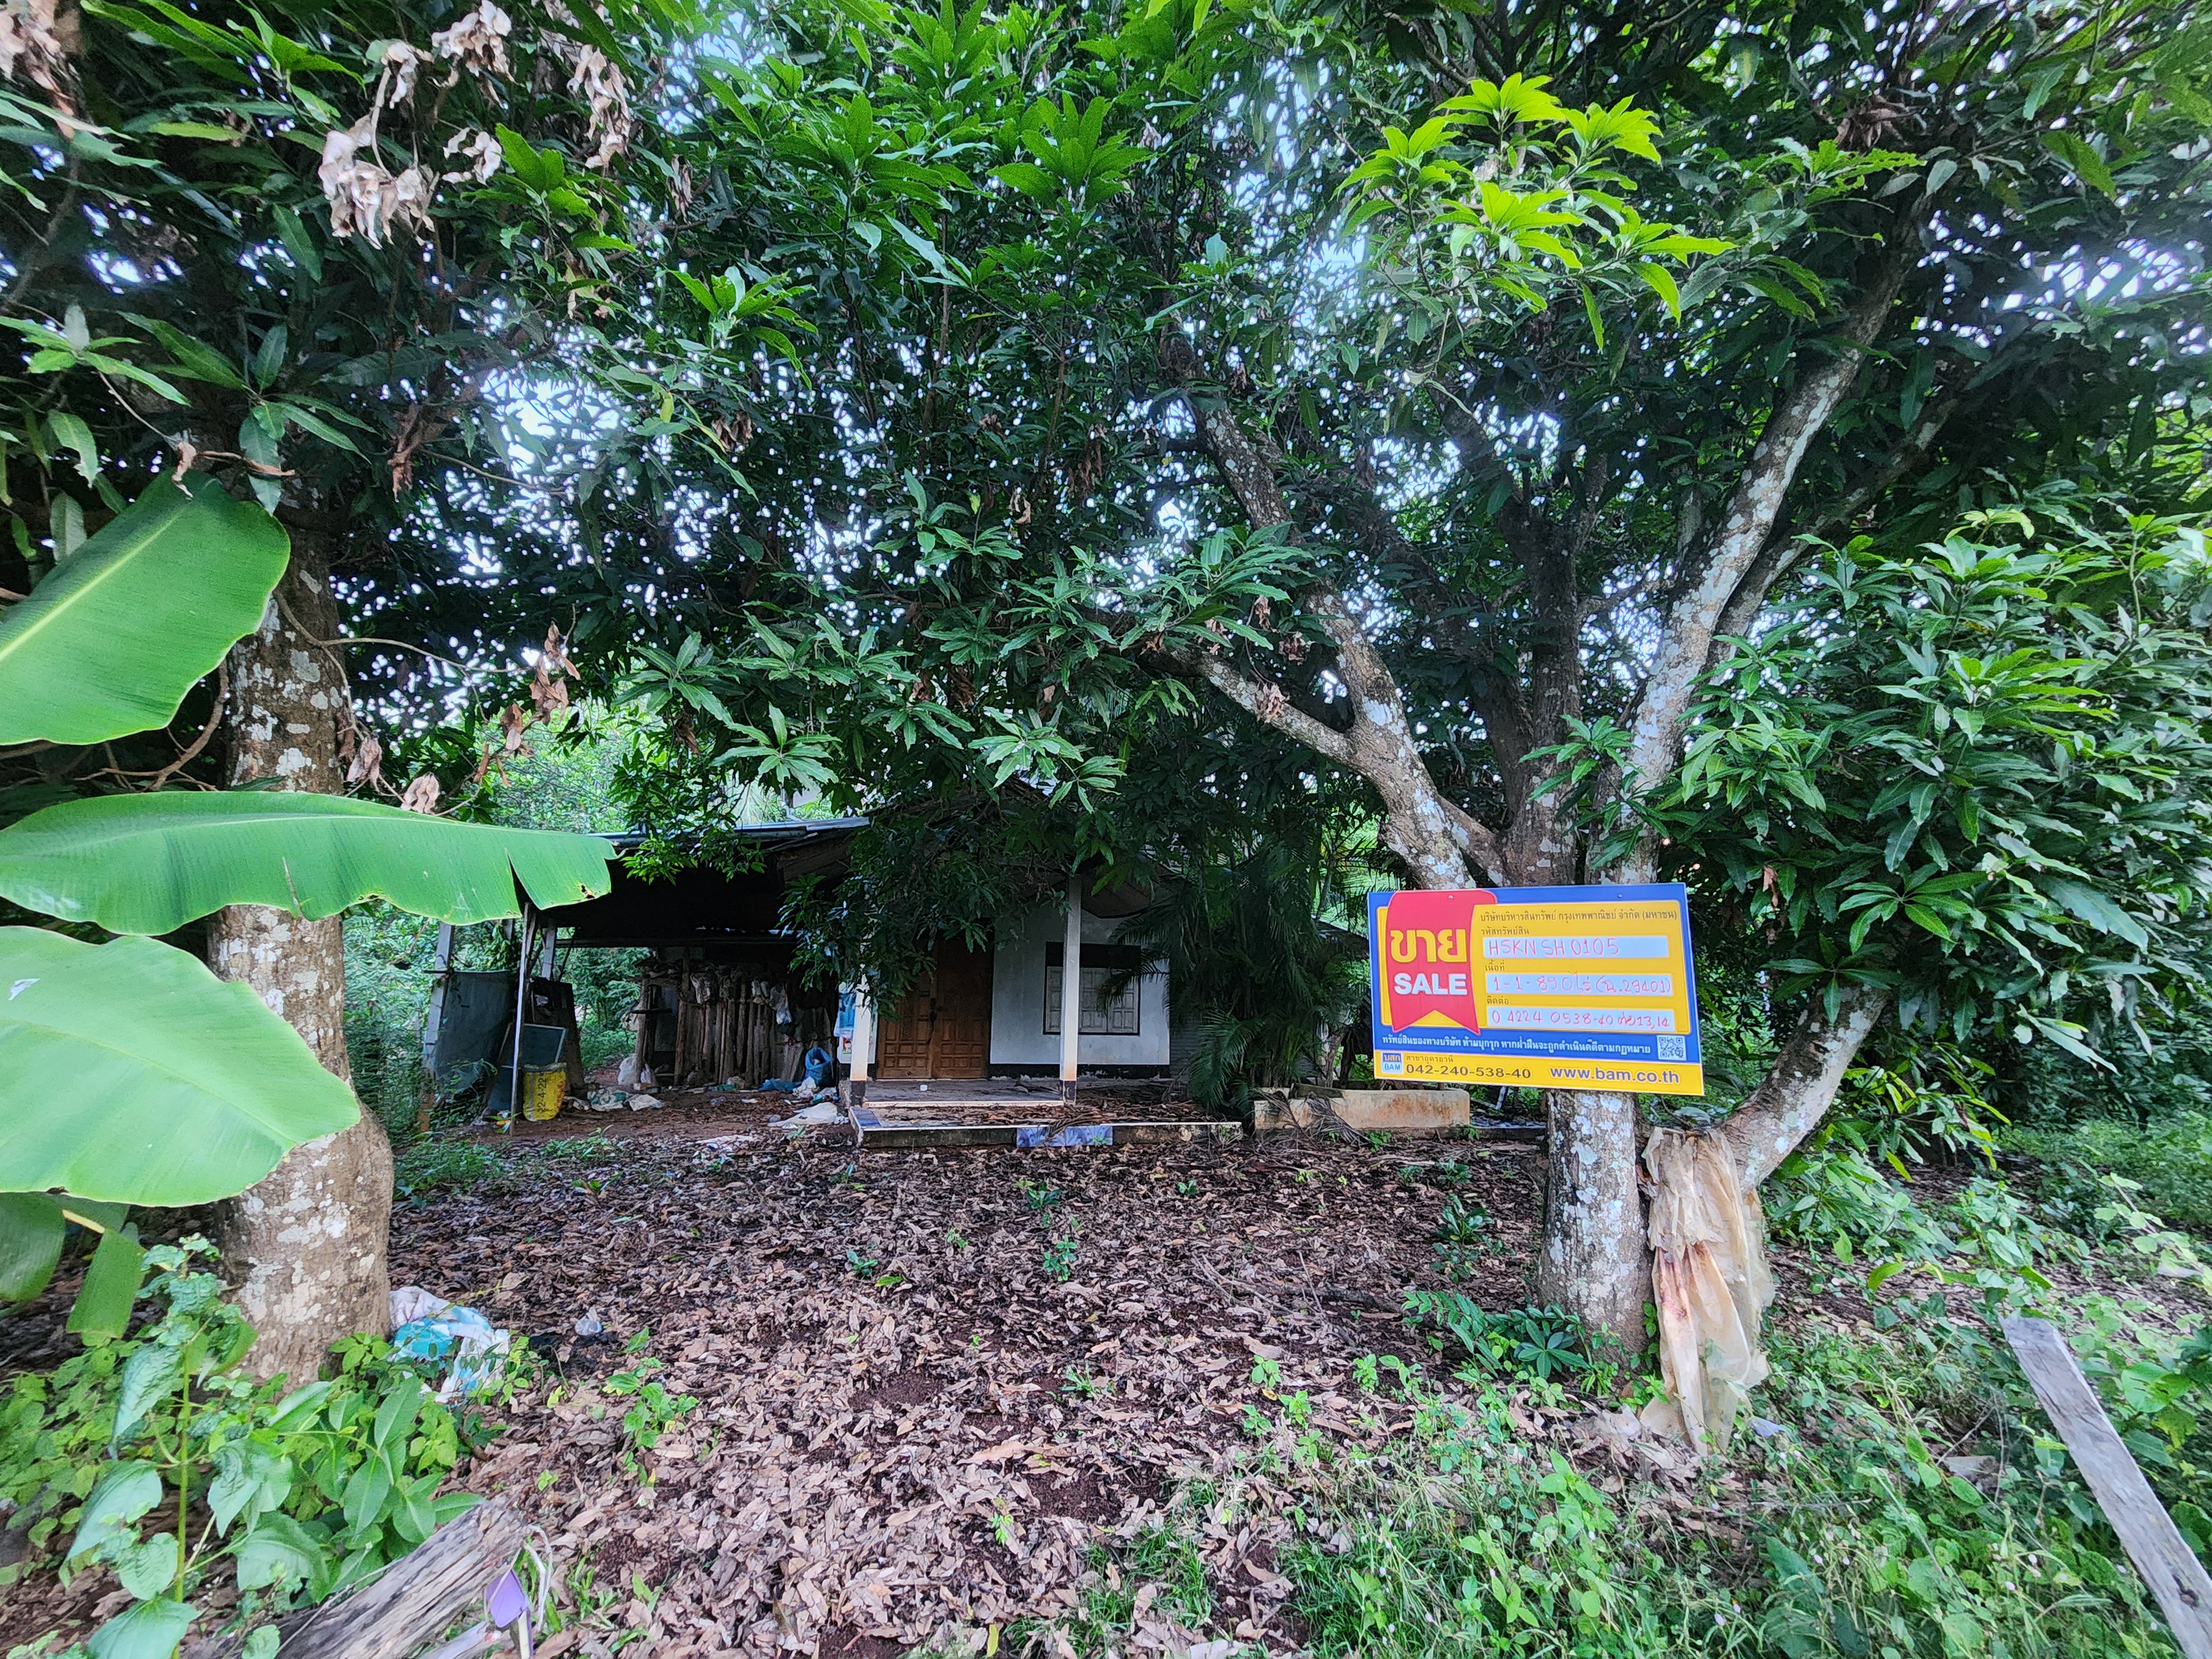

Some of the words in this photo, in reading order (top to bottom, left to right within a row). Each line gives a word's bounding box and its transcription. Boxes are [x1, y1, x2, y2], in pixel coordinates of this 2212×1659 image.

[1480, 909, 1557, 921] บริษัทบริหารสินทรัพย์
[1559, 909, 1616, 924] กรุงเทพพาณิชย์
[1619, 908, 1640, 920] จำกัด
[1642, 910, 1677, 921] (มหาชน)
[1481, 925, 1529, 935] รหัสทรัพย์สิน
[1390, 928, 1467, 963] ขาย
[1485, 959, 1505, 972] เนื้อที่
[1394, 973, 1467, 995] SALE
[1486, 995, 1509, 1005] ติดต่อ
[1383, 1034, 1461, 1046] ทรัพย์สินของทางบริษัท
[1462, 1036, 1500, 1051] ห้ามบุกรุก
[1384, 1063, 1401, 1071] BAM
[1406, 1055, 1454, 1064] สาขาอุดรธานี
[1406, 1064, 1531, 1079] 042-240-538-40
[1550, 1067, 1679, 1083] www.bam.co.th
